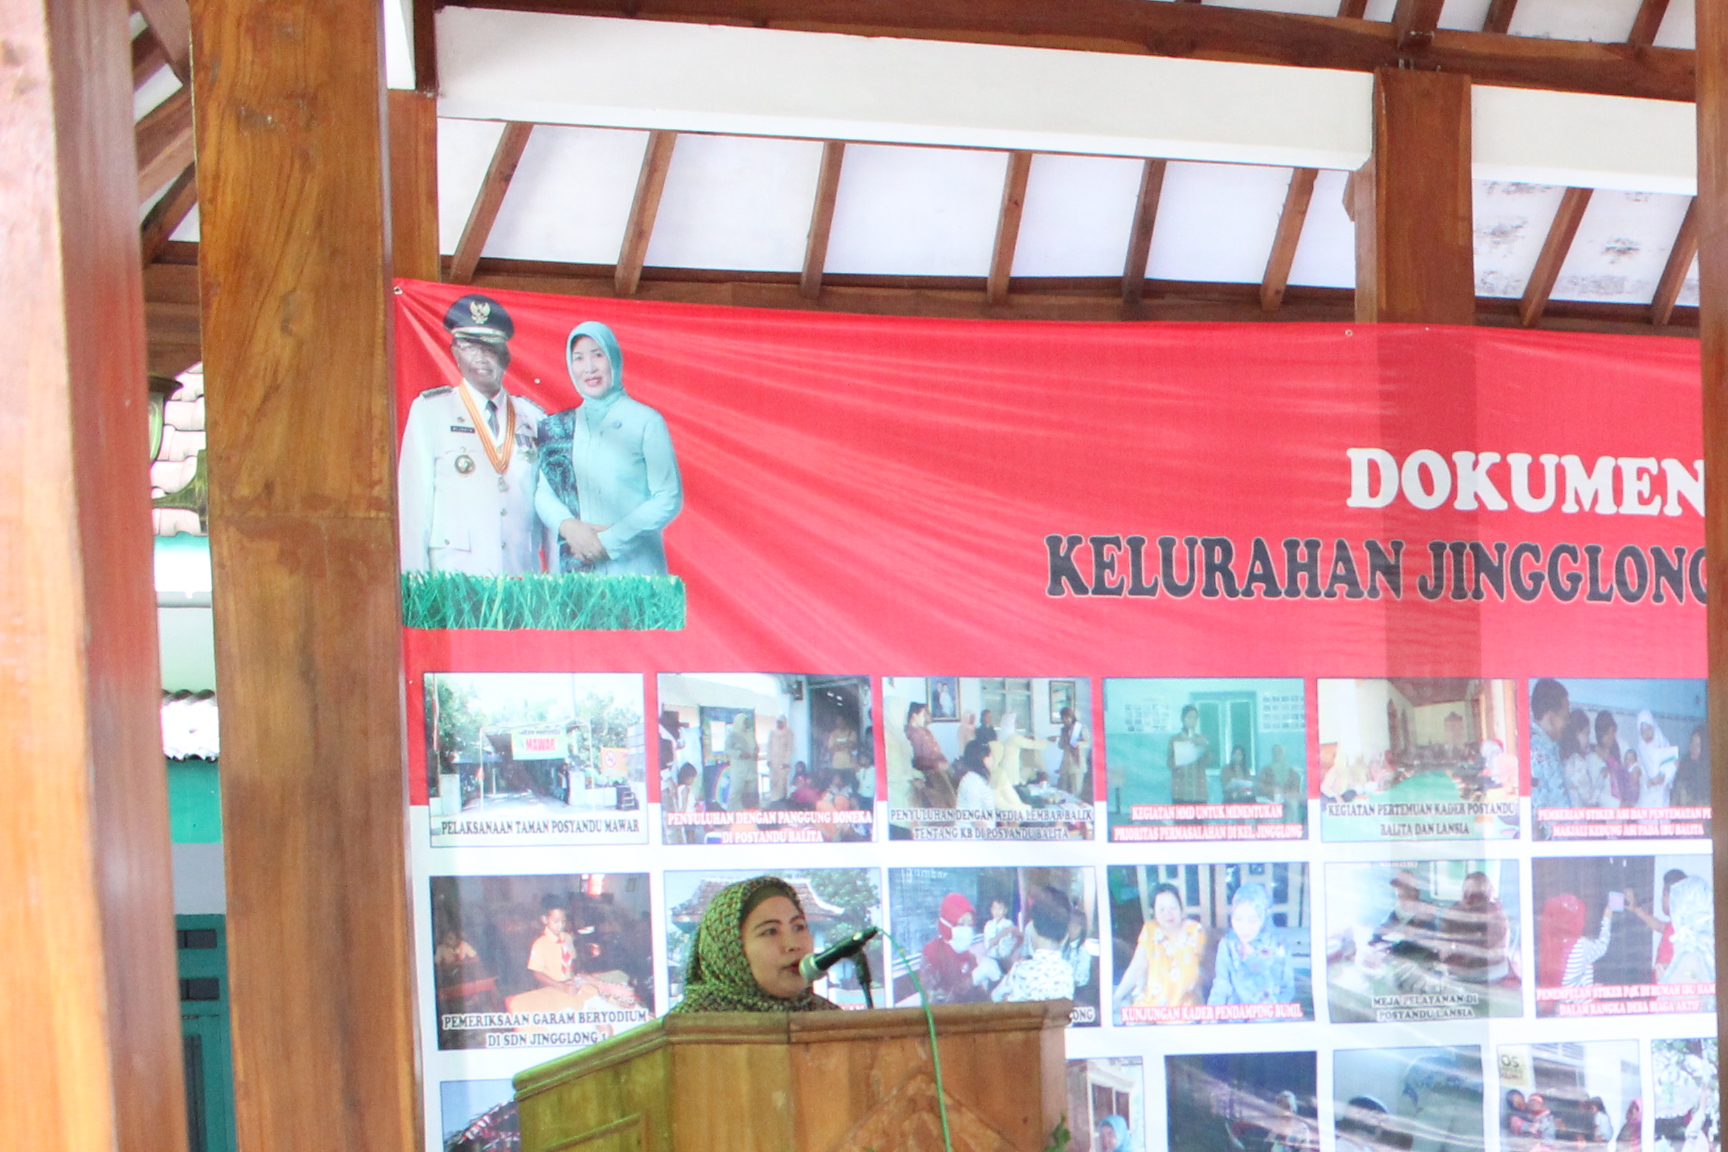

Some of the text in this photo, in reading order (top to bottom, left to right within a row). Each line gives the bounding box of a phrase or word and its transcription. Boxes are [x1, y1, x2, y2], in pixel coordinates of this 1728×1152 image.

[1347, 447, 1705, 517] DOKUMEN
[1043, 533, 1405, 601] KELURAHAN
[890, 809, 1094, 821] PENYULUHAN DENGAN MEDIA LEMBAR BALIK
[1132, 806, 1174, 819] KEGIATAN
[1195, 806, 1225, 818] UNTUK
[1226, 805, 1283, 818] MENENTUKAN
[1328, 803, 1515, 816] KEGIATAN PERTEMUAN KADER POSYANDU
[668, 810, 873, 825] PENYULUHAN DENGAN PANGGUNG BONEKA
[441, 819, 640, 834] PELAKSANAAN TAMAN POSYANDU MAWAR
[914, 827, 1069, 838] TENTANG KB DI POSYANDU BALITA
[1114, 827, 1159, 840] PRIORITAS
[1160, 826, 1226, 840] PERMASALAHAN
[1227, 826, 1237, 839] DI
[1256, 824, 1303, 839] JINGGLONG
[1380, 823, 1470, 835] BALITA DAN LANSIA
[722, 831, 824, 843] DI POSYANDU BALITA
[1698, 985, 1716, 995] HAM
[1372, 994, 1478, 1007] MEJA PELAYANAN DI
[443, 1010, 647, 1029] PEMERIKSAAN GARAM BERYODIUM
[1122, 1007, 1181, 1022] KUNJUNGAN
[1182, 1006, 1214, 1020] KADER
[1215, 1005, 1273, 1019] PENDAMPING
[1378, 1008, 1474, 1020] POSYANDU LANSIA
[487, 1035, 501, 1046] DI
[503, 1034, 528, 1046] SDN
[529, 1032, 598, 1045] JINGGLONG
